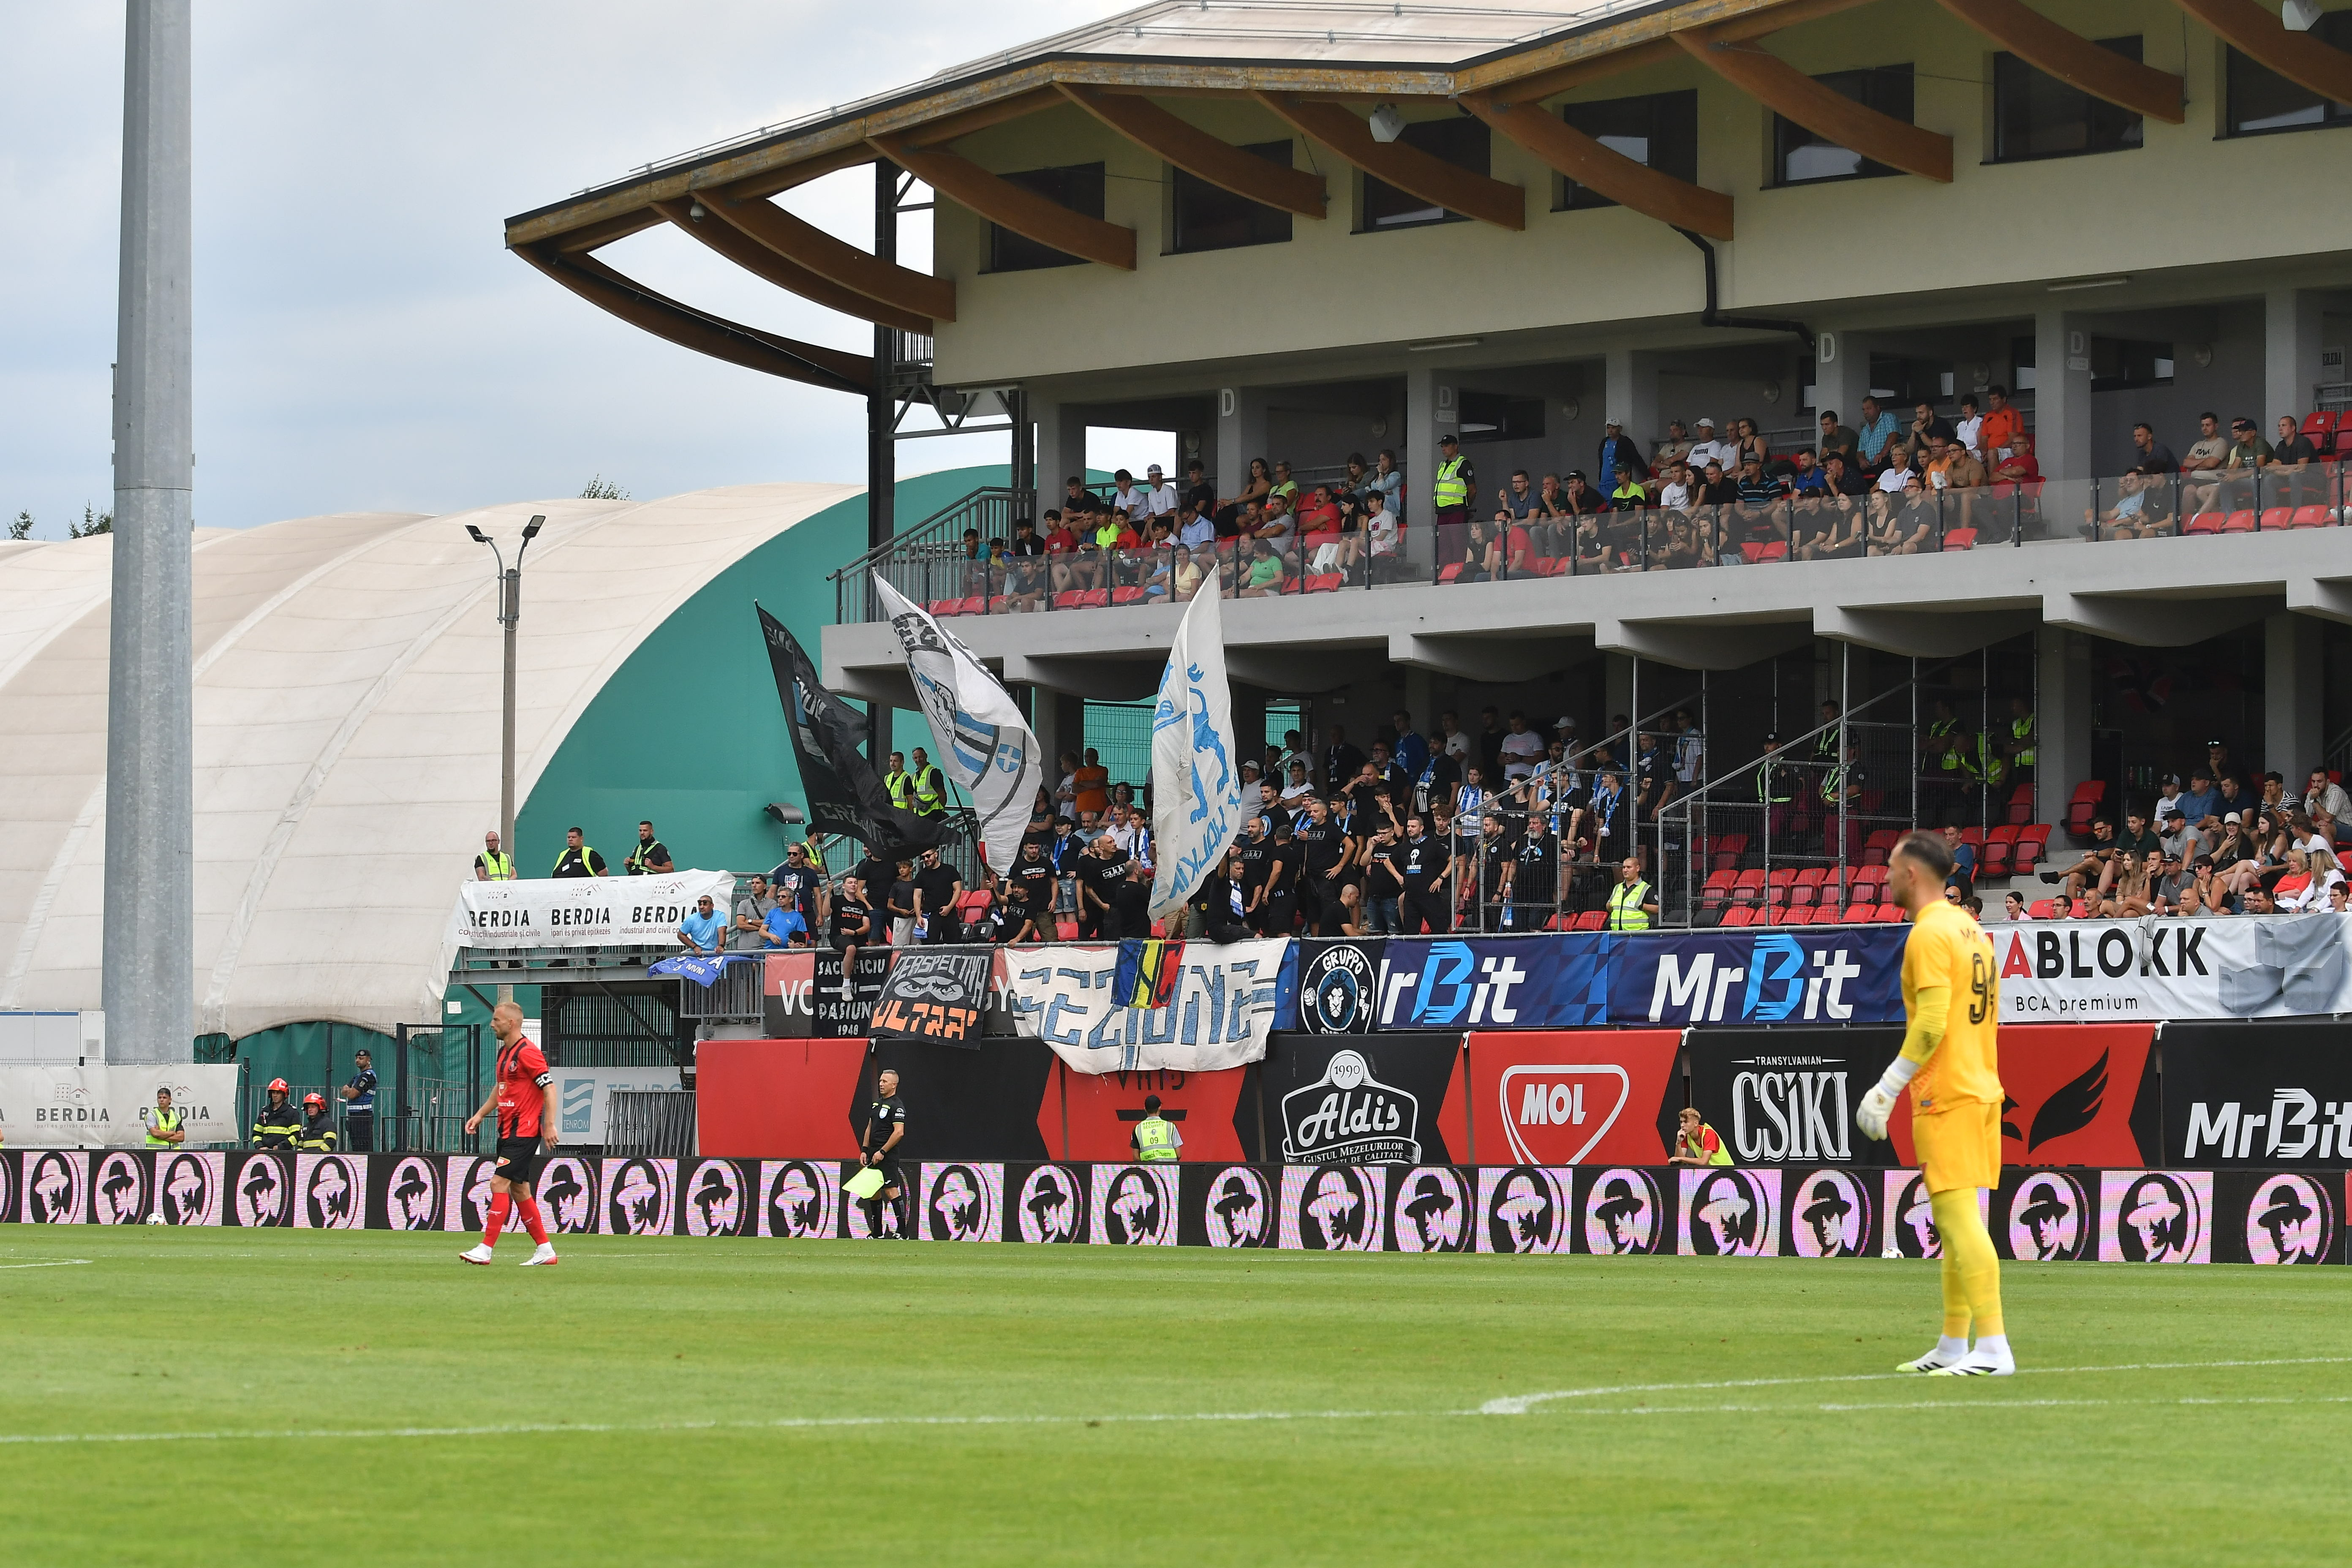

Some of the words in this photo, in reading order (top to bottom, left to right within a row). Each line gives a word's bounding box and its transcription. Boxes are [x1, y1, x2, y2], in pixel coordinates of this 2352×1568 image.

[1820, 332, 1836, 363] D
[2071, 331, 2083, 354] D
[1222, 388, 1235, 416] D
[1440, 386, 1452, 407] D
[469, 910, 530, 927] BERDIA
[552, 908, 610, 925] BERDIA
[526, 929, 541, 937] civile
[551, 928, 563, 938] ipari
[619, 926, 645, 934] industrial
[658, 926, 671, 934] civil
[1322, 950, 1364, 975] GRUPPO
[1985, 927, 2209, 979] ABLOKK
[686, 964, 705, 976] MVM
[818, 958, 885, 976] SACFICIU
[1648, 934, 1860, 1022] MrBit
[2016, 996, 2051, 1012] BCA
[2059, 993, 2138, 1015] premium
[838, 1024, 859, 1035] 1948
[1334, 1061, 1361, 1078] 1990
[1755, 1055, 1822, 1066] TRANSYLVANIAN
[36, 1108, 110, 1122] BERDIA
[139, 1106, 210, 1120] BDIA
[1520, 1083, 1587, 1125] MOL
[564, 1120, 589, 1129] TENROM
[1298, 1092, 1400, 1147] Aldis
[2184, 1088, 2352, 1159] MrBit
[1303, 1151, 1337, 1163] GUSTUL
[1339, 1142, 1404, 1157] MEZELURILOR
[1365, 1152, 1403, 1161] CALITATE
